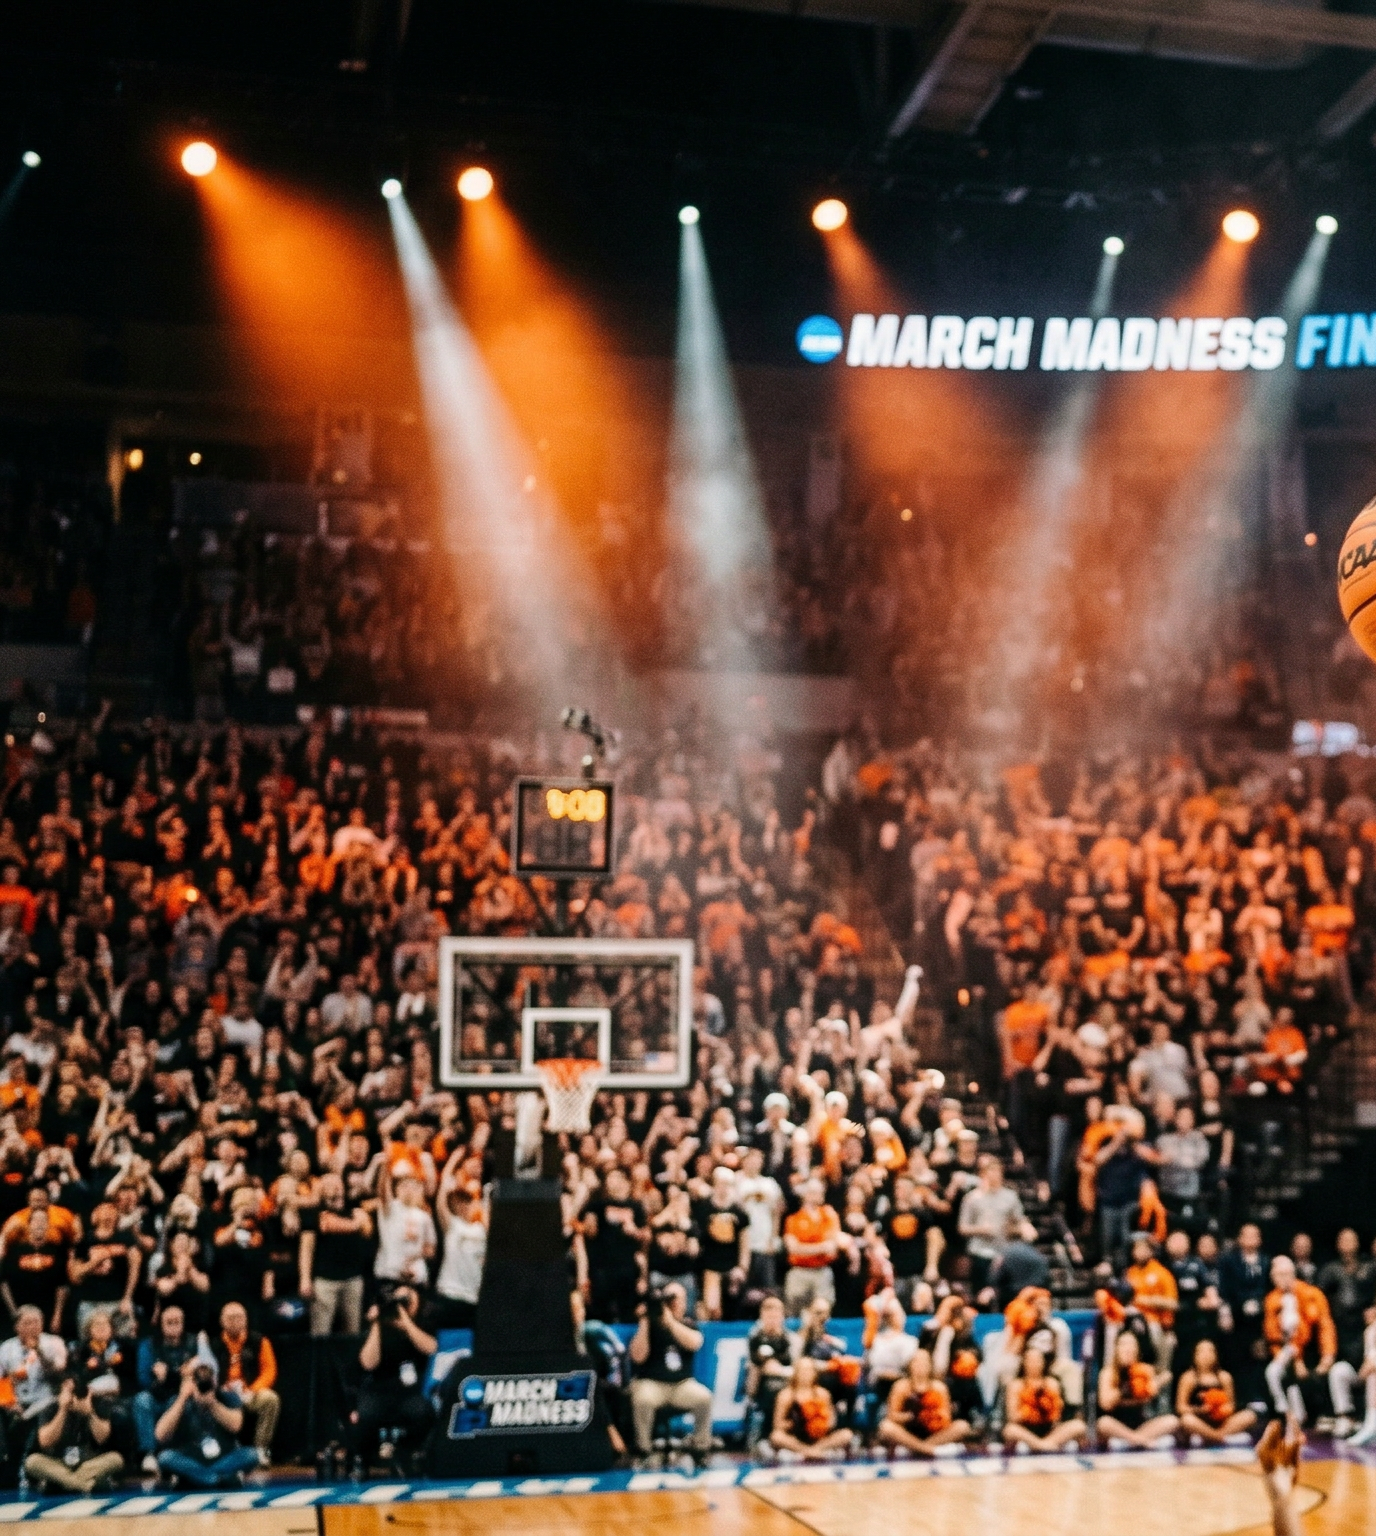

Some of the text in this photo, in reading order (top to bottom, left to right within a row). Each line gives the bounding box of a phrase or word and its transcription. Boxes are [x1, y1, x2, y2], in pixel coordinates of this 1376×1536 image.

[846, 313, 1035, 370] MARCH
[1039, 316, 1288, 372] MADNESS
[484, 1379, 557, 1404] MARCH
[491, 1398, 591, 1427] MADNESS
